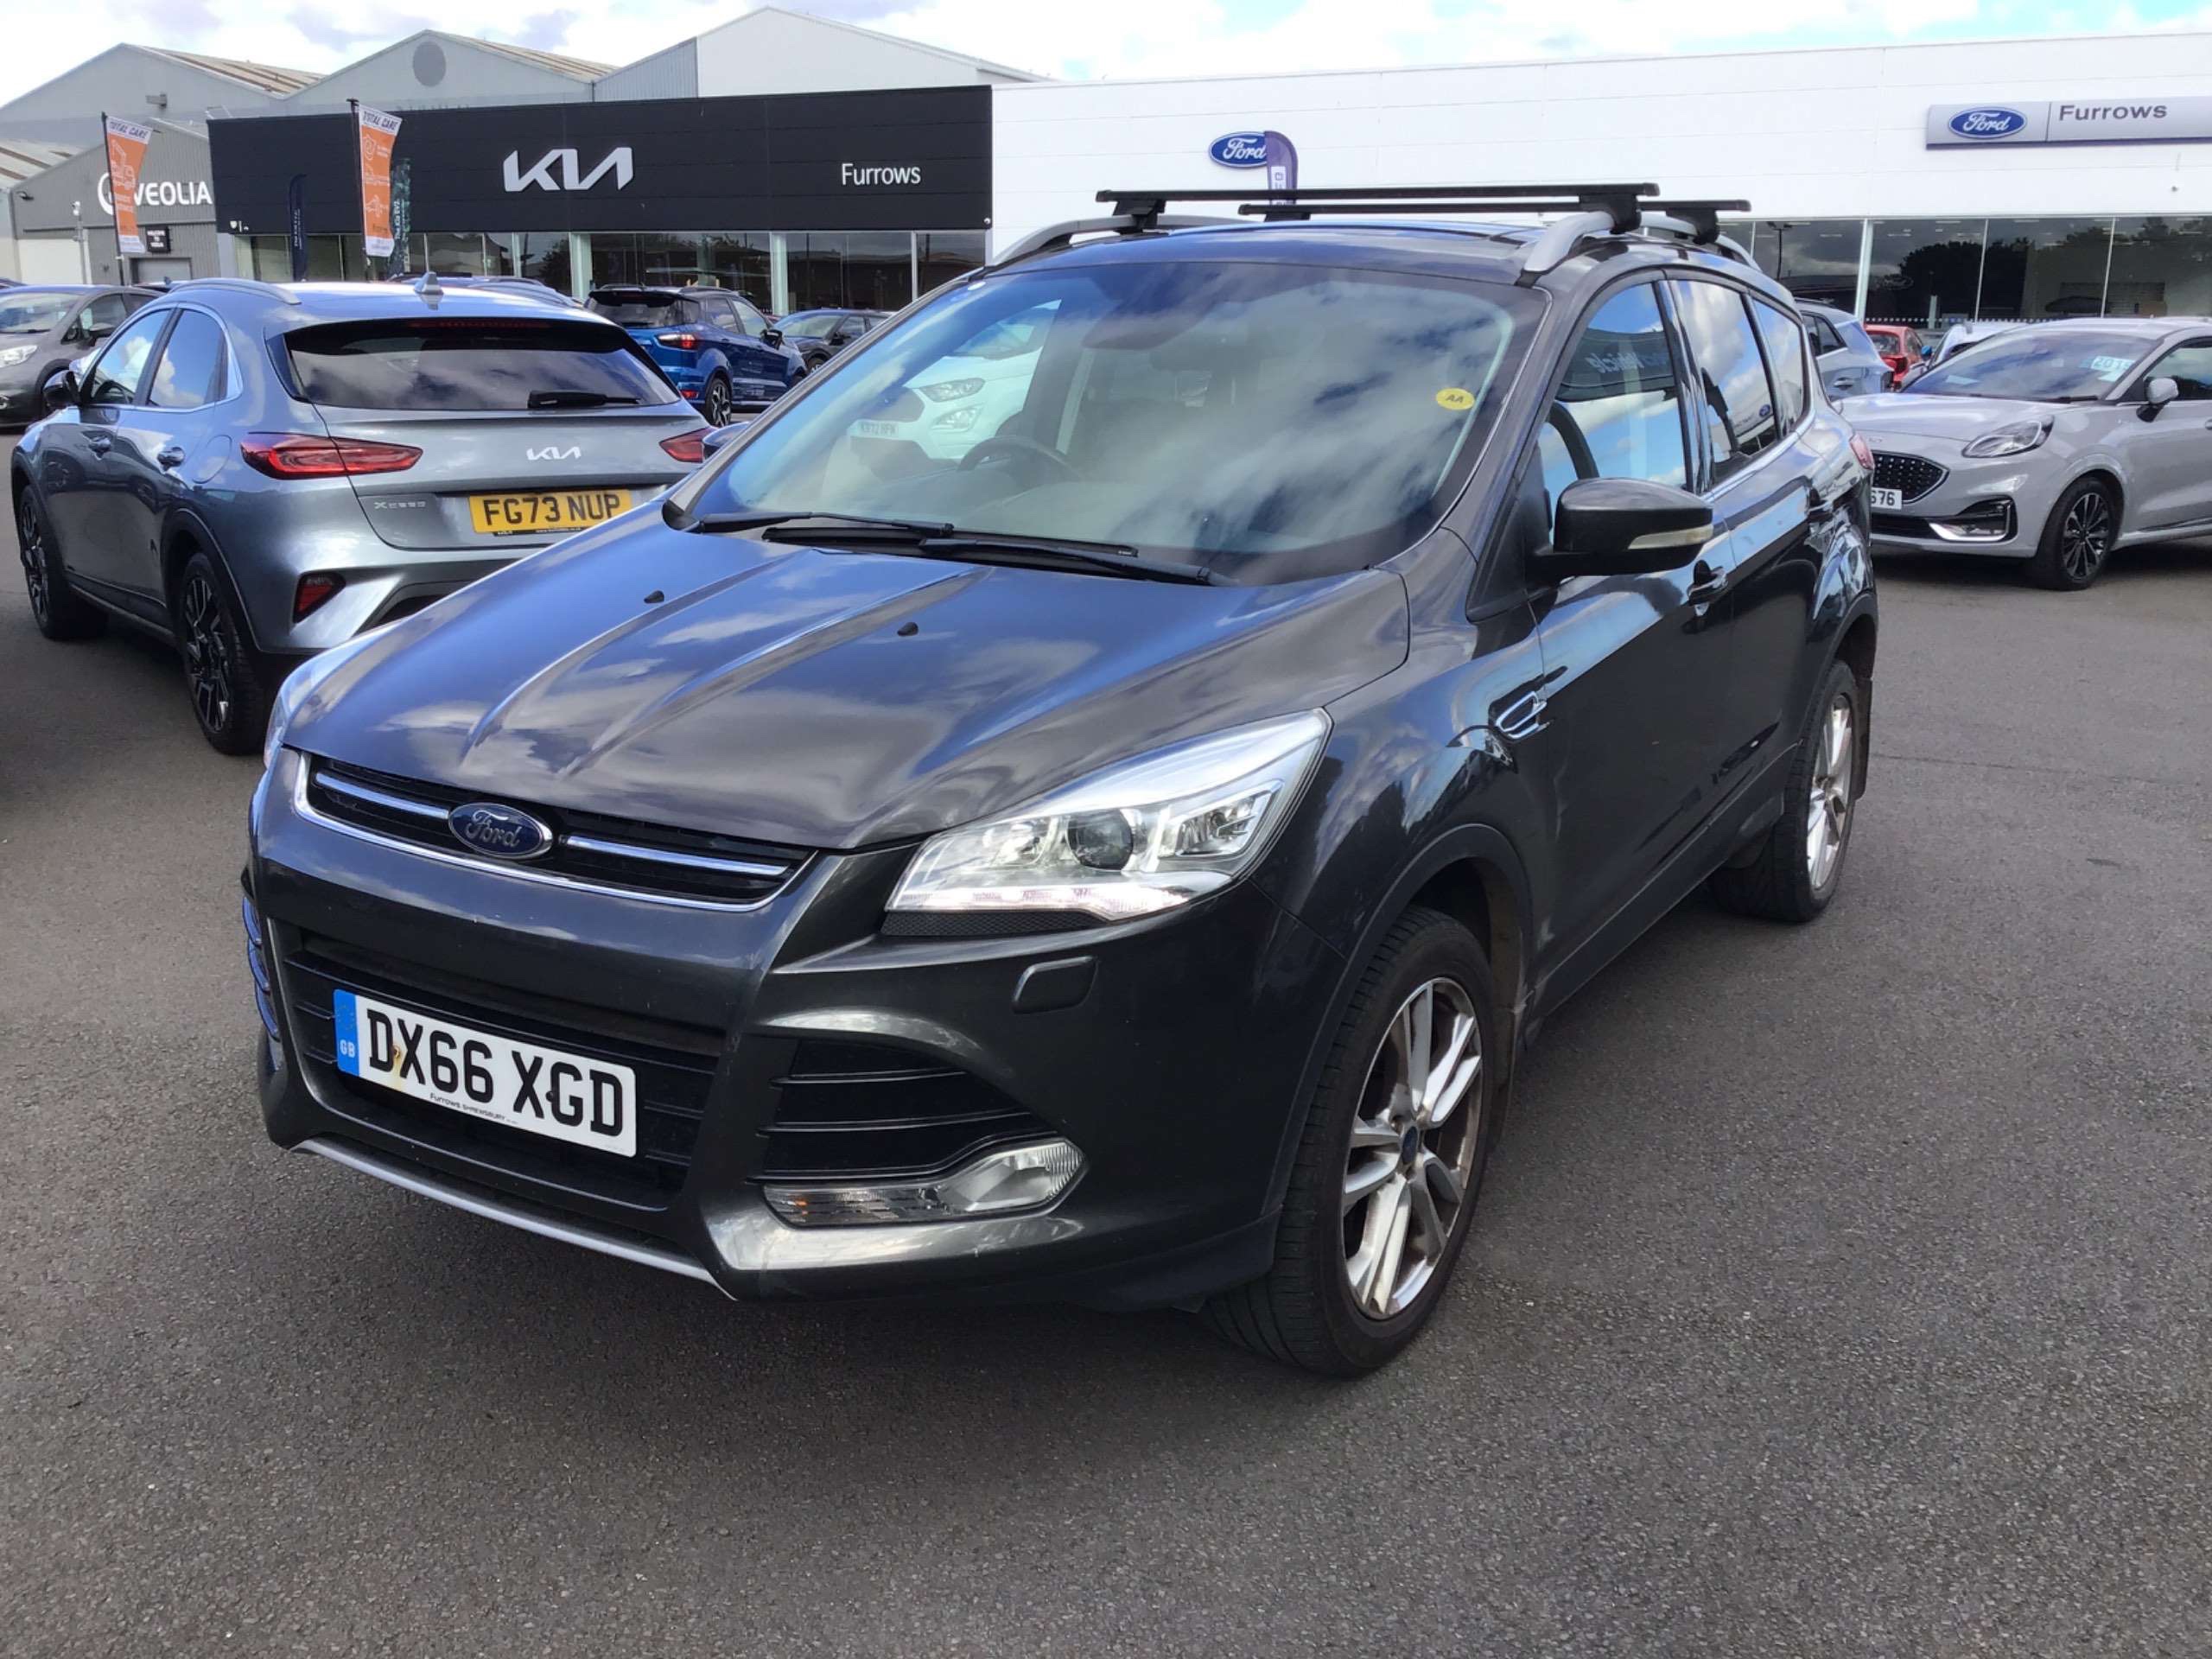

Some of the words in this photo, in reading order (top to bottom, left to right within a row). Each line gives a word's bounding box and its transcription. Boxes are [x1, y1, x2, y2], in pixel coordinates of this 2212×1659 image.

[1962, 111, 2012, 132] Ford
[2058, 103, 2168, 121] Furrows
[128, 126, 149, 140] CARE
[381, 116, 399, 130] CARE
[1223, 137, 1267, 160] Ford
[503, 147, 633, 192] KIA
[841, 162, 922, 186] Furrows
[134, 181, 213, 207] VEOLIA
[1445, 394, 1465, 404] AA
[526, 446, 582, 461] KIA
[483, 495, 561, 526] FG73
[566, 493, 620, 522] NUP
[465, 809, 523, 848] Ford
[340, 1039, 356, 1058] GB
[366, 1007, 494, 1104] DX66
[511, 1050, 623, 1137] XGD
[430, 1091, 462, 1110] Furrows
